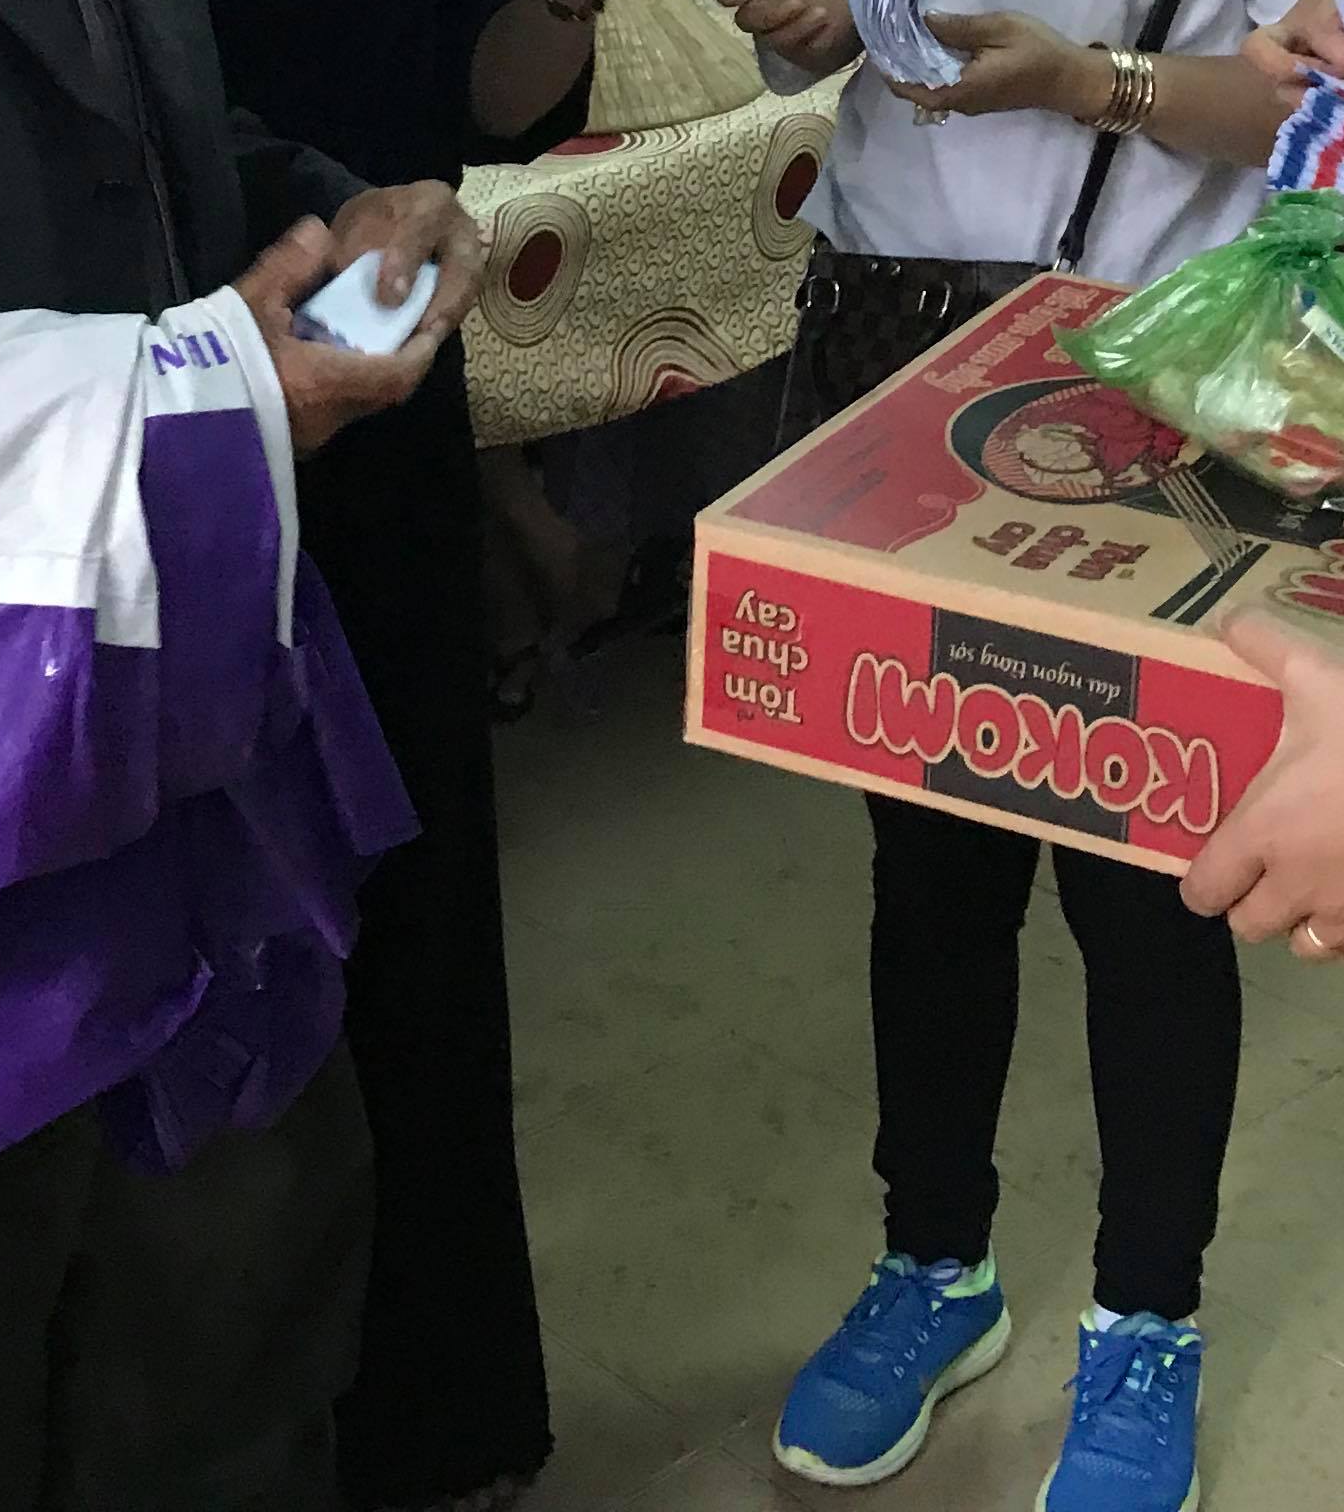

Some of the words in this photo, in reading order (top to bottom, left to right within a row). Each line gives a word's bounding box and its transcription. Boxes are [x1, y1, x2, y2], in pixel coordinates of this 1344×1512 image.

[971, 520, 1037, 557] cay
[1009, 524, 1090, 571] chua
[735, 589, 799, 633] cay
[721, 625, 809, 678] chua
[947, 640, 975, 663] sợi
[1031, 661, 1083, 691] ngon
[1087, 679, 1122, 706] dai
[722, 673, 803, 725] Tôm
[846, 653, 1219, 834] KOKOMI
